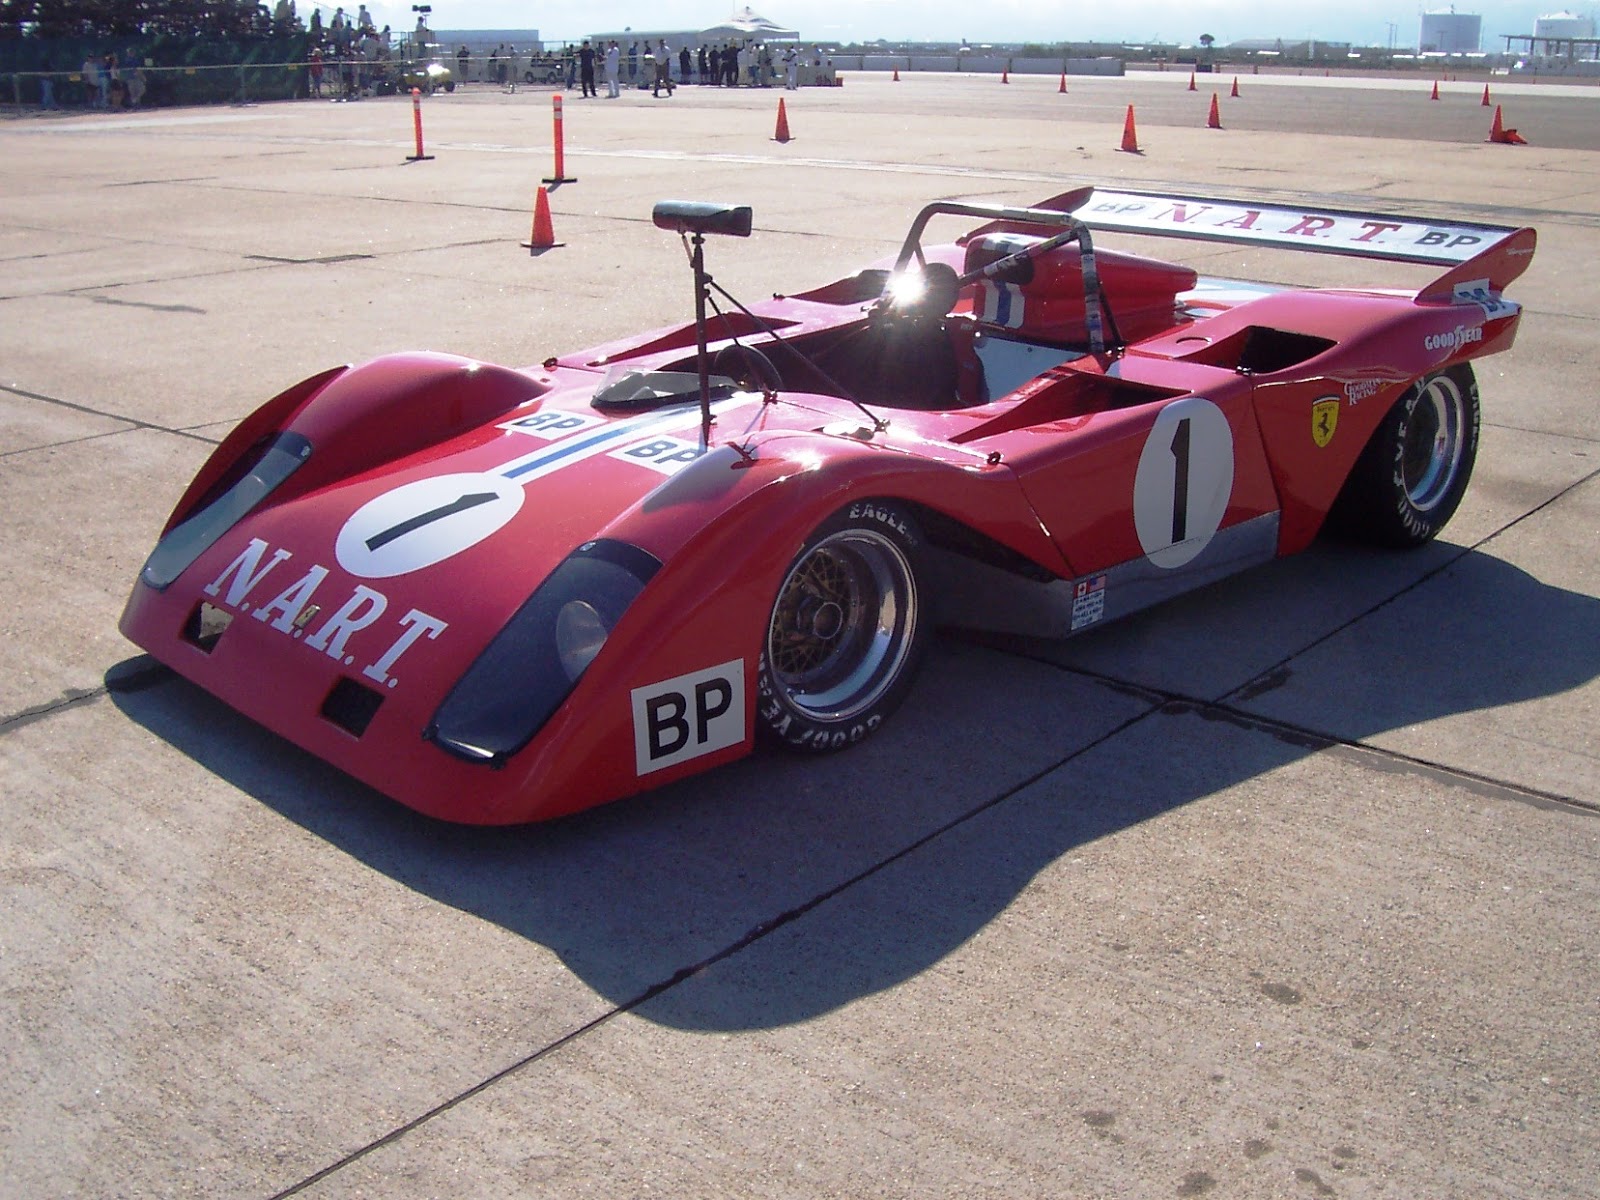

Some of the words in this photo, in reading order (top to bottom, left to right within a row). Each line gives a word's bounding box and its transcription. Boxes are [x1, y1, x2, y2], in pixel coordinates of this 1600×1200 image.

[1414, 231, 1483, 249] BP
[1424, 325, 1482, 350] GOODYEAR
[511, 412, 585, 431] BP
[624, 440, 702, 464] BP
[1171, 418, 1190, 543] 1
[365, 492, 499, 551] 1
[848, 503, 907, 535] EAGLE
[203, 537, 449, 689] N.A.R.T.
[646, 676, 733, 761] BP
